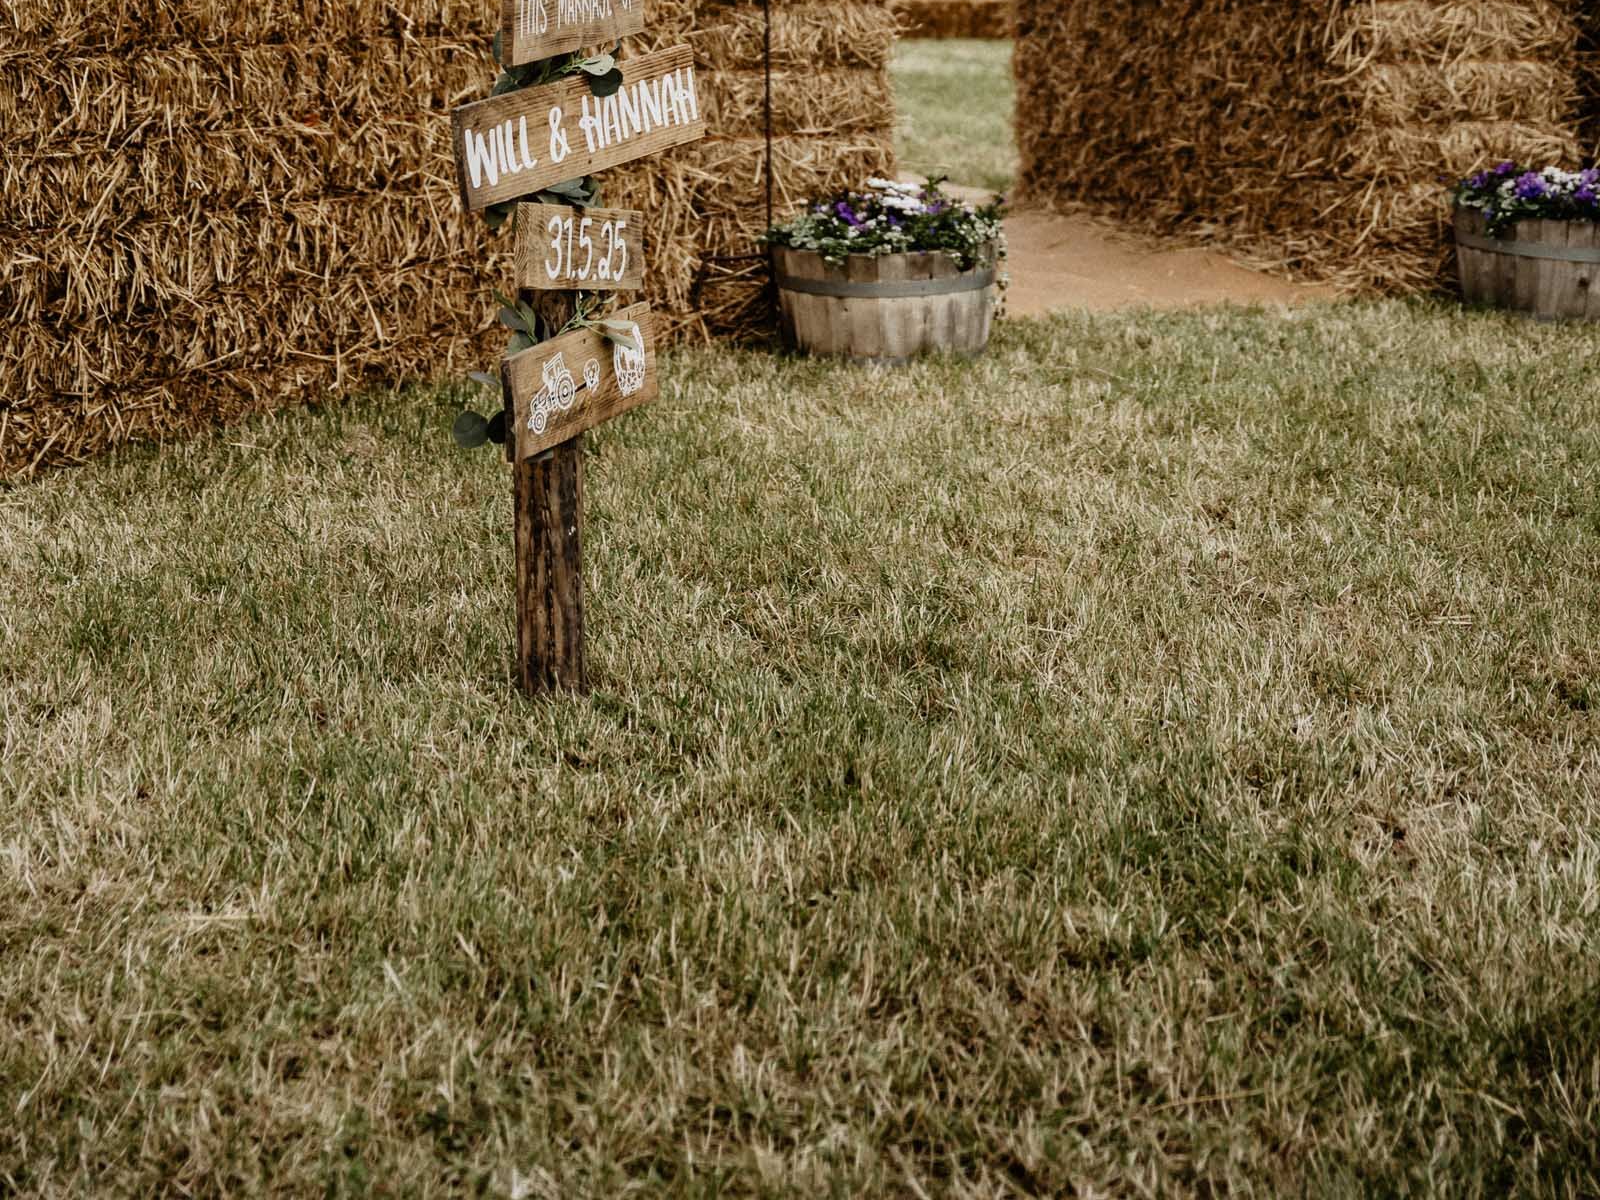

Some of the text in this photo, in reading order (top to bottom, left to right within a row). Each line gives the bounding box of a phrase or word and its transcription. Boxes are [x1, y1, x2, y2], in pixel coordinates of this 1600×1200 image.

[464, 66, 698, 189] WILL & HANNAH
[545, 215, 627, 282] 31.5.25
